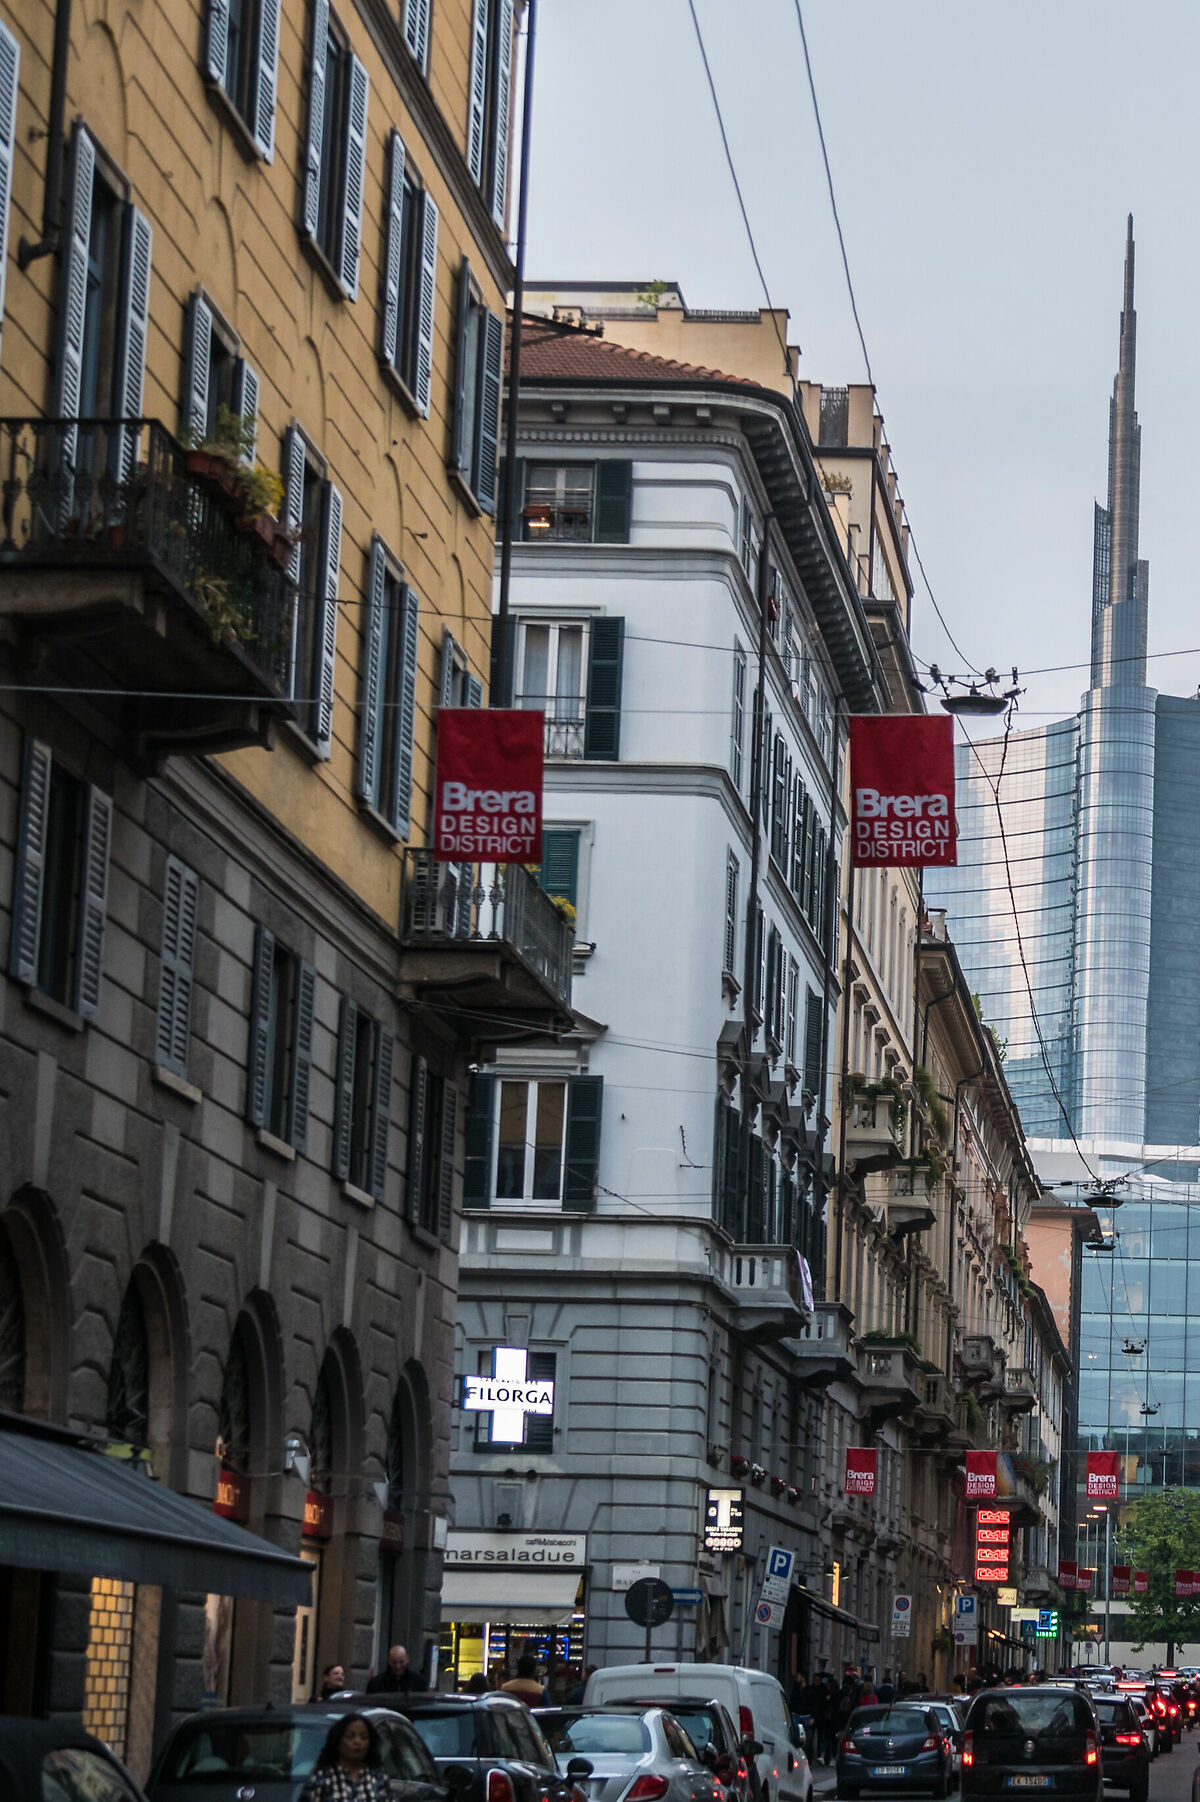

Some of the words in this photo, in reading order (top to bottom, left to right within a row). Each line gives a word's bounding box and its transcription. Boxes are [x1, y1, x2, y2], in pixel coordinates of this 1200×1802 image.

[443, 781, 536, 813] Brera
[856, 788, 949, 818] Brera
[441, 815, 536, 834] DESIGN
[856, 820, 950, 839] DESIGN
[440, 834, 535, 854] DISTRICT
[857, 839, 949, 858] DISTRICT
[466, 1386, 553, 1405] FILORGA
[847, 1470, 874, 1480] Brera
[967, 1472, 995, 1482] Brera
[1088, 1473, 1116, 1483] Brera
[708, 1489, 742, 1527] T
[774, 1553, 787, 1573] P
[962, 1599, 971, 1611] P
